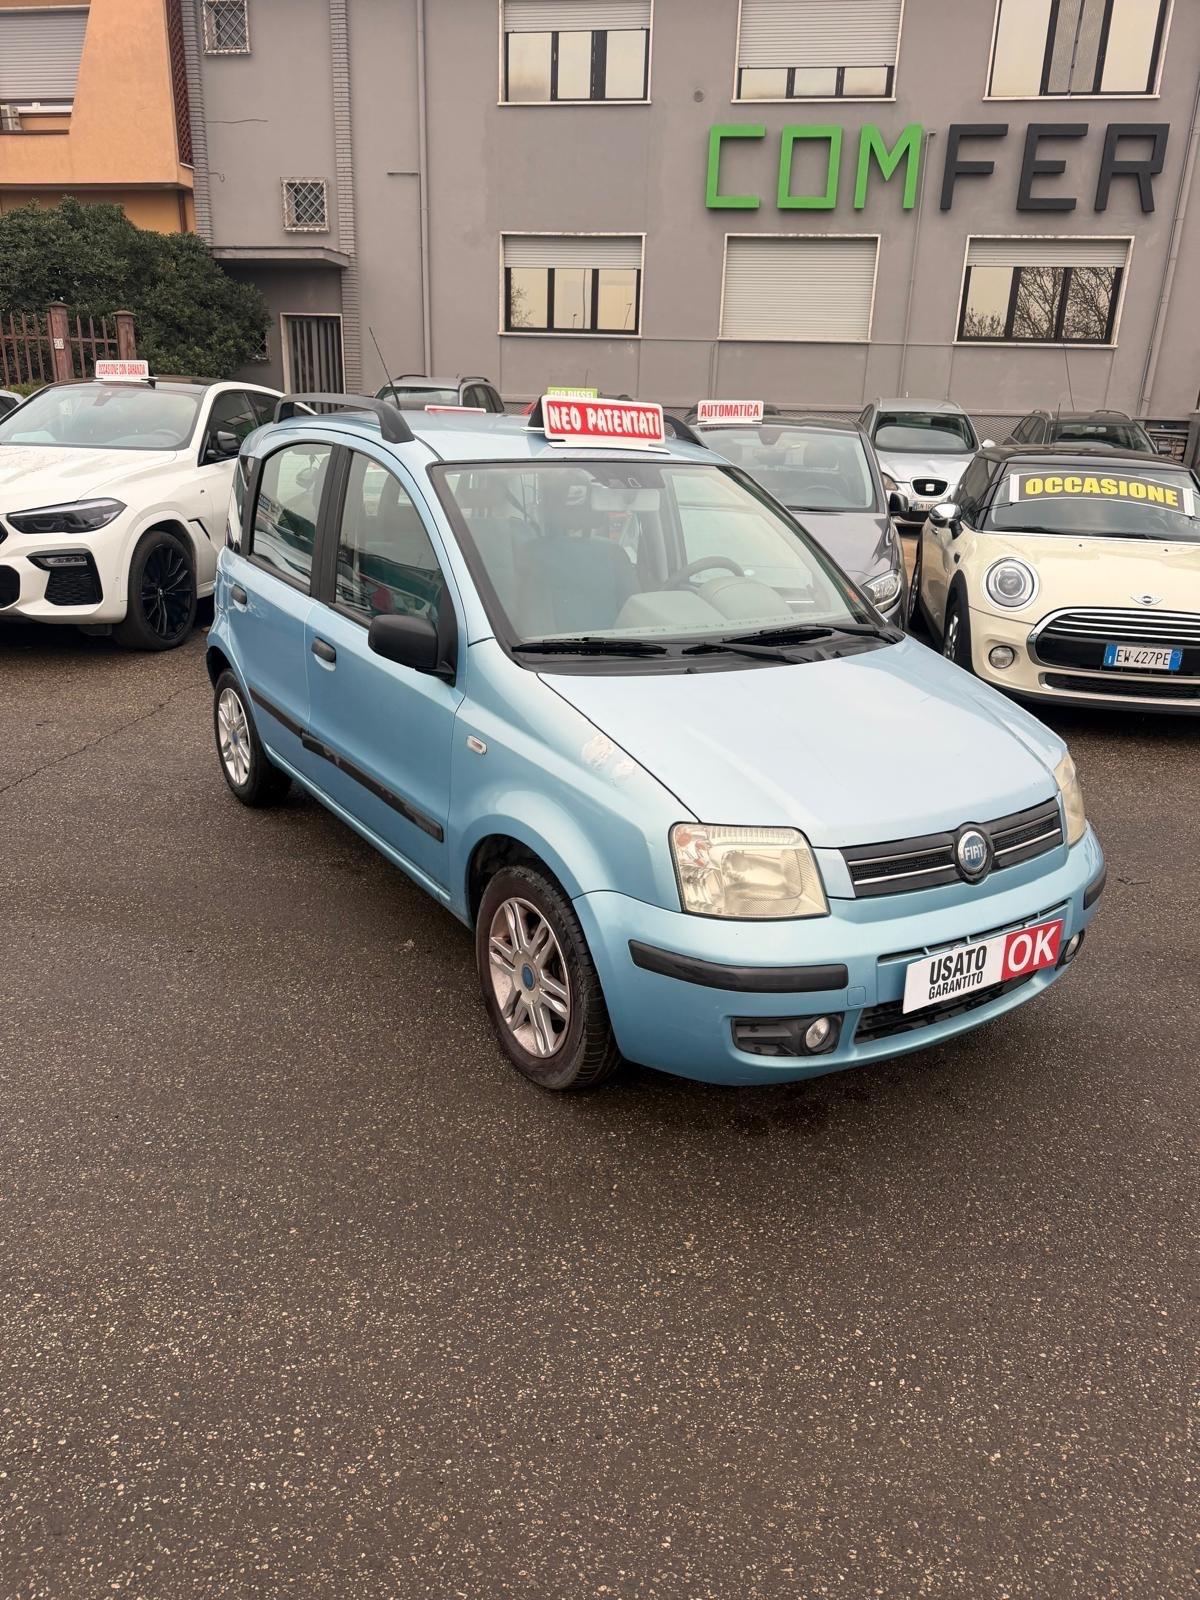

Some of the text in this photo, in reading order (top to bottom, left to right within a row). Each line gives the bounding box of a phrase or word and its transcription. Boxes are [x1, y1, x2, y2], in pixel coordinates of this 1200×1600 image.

[706, 123, 1170, 212] COMFER
[548, 404, 660, 436] NEO PATENTATI
[700, 404, 760, 417] AUTOMATICA
[1025, 476, 1179, 507] OCCASIONE
[964, 843, 984, 861] FIAT
[1007, 924, 1059, 973] OK
[929, 945, 987, 986] USATO
[928, 970, 984, 1000] GARANTITO
